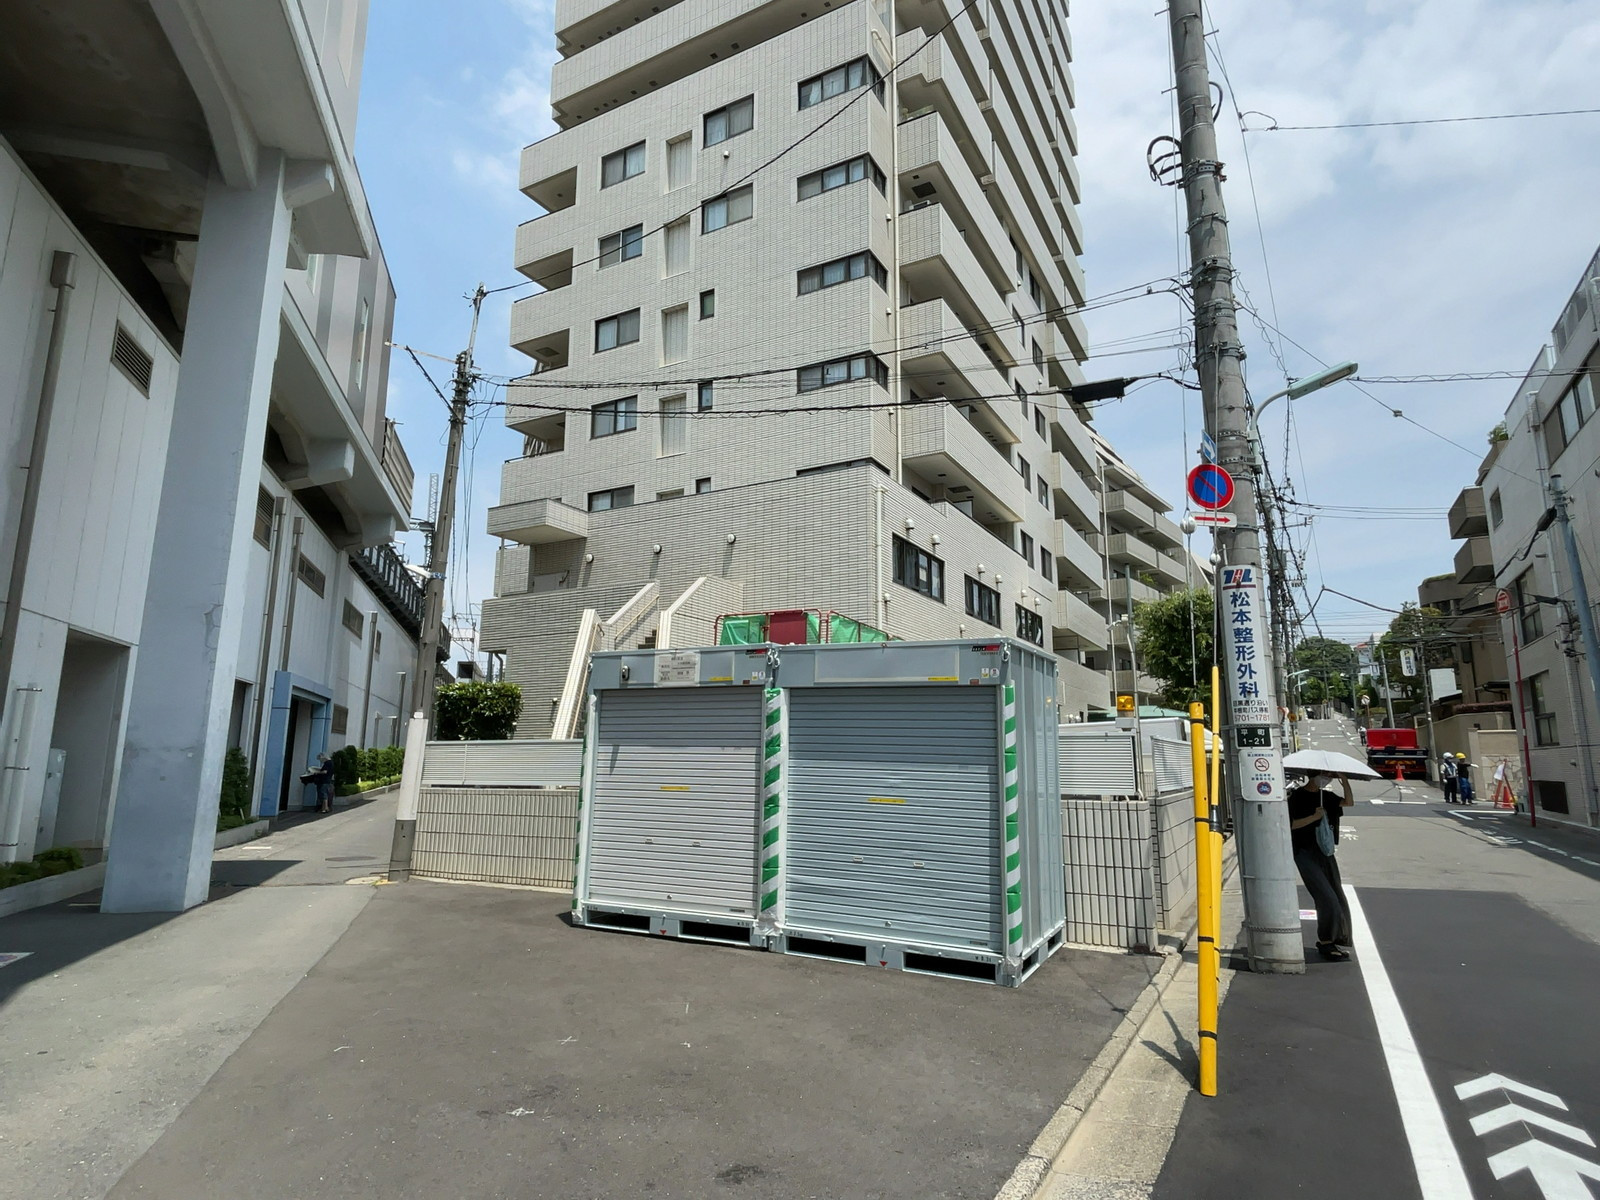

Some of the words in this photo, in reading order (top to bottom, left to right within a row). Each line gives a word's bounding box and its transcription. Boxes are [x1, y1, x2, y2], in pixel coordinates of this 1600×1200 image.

[1230, 591, 1259, 698] 松本整形外科
